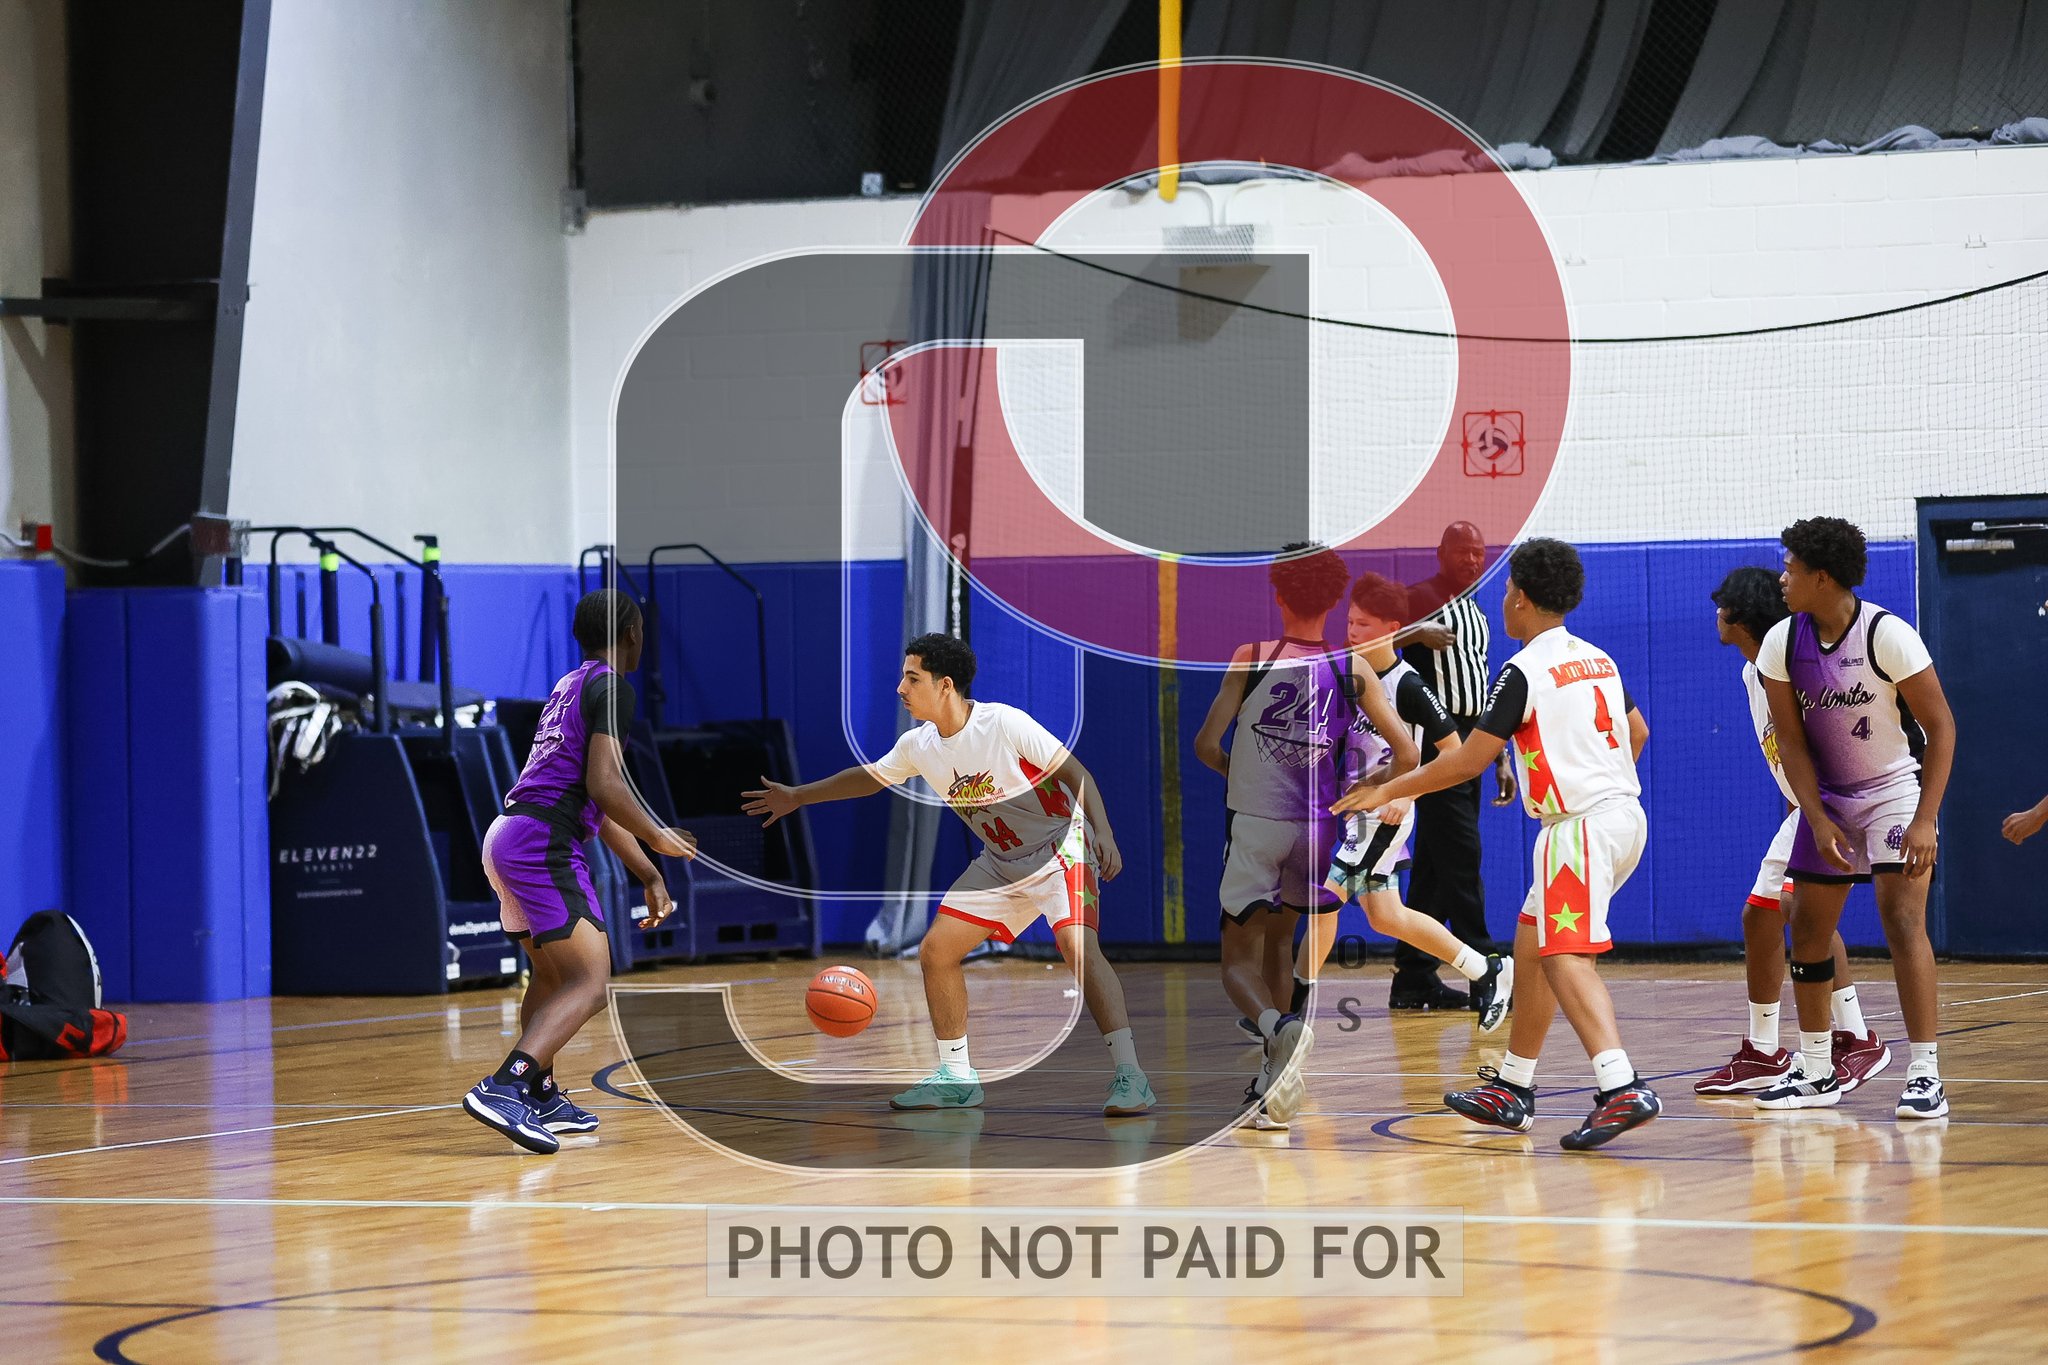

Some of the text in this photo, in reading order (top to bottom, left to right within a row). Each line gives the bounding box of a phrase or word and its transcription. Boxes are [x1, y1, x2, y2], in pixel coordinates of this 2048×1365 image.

[1422, 686, 1447, 720] culture
[1486, 668, 1512, 712] culture
[1259, 681, 1333, 734] 24
[1851, 715, 1873, 741] 4
[279, 844, 378, 864] ELEVEN22
